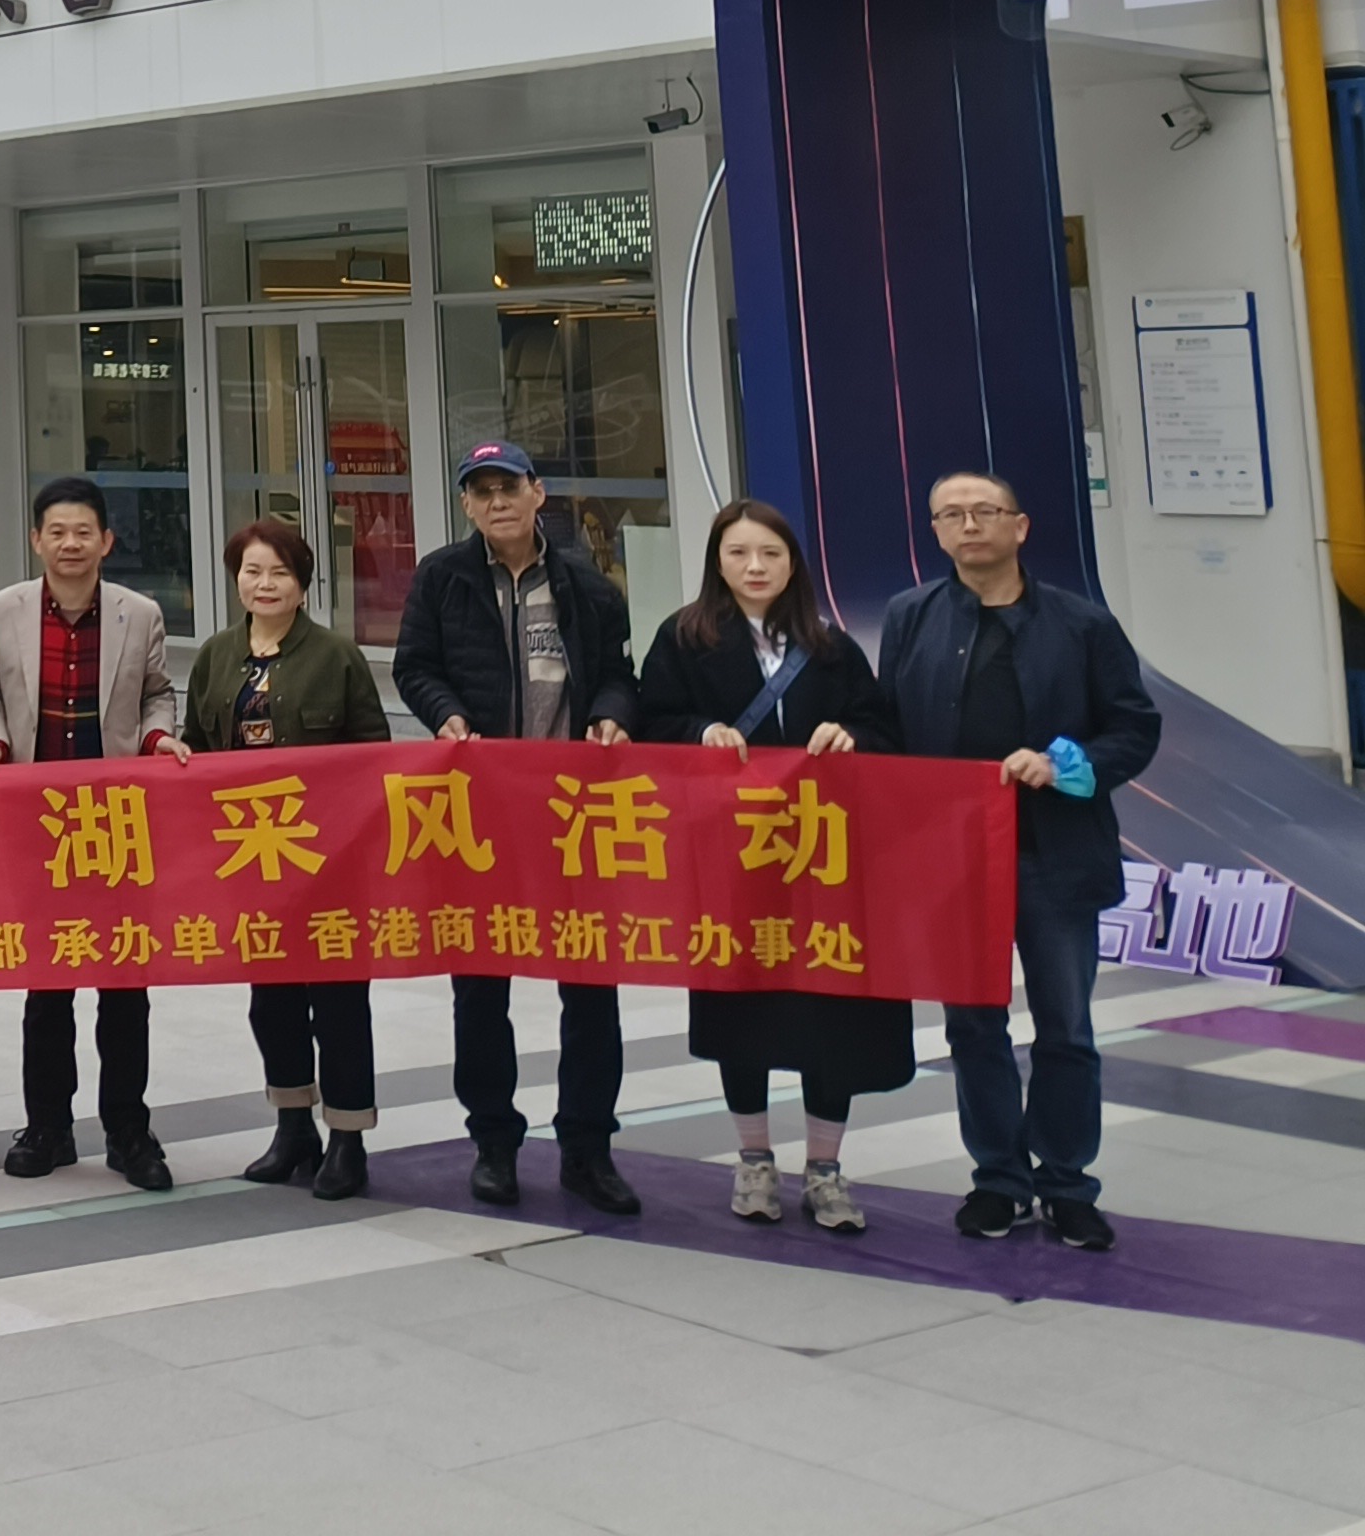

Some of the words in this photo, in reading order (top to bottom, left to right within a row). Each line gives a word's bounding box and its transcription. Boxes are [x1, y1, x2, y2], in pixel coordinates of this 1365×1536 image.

[53, 913, 286, 969] 承办单位
[310, 904, 865, 975] 香港商报浙江办事处
